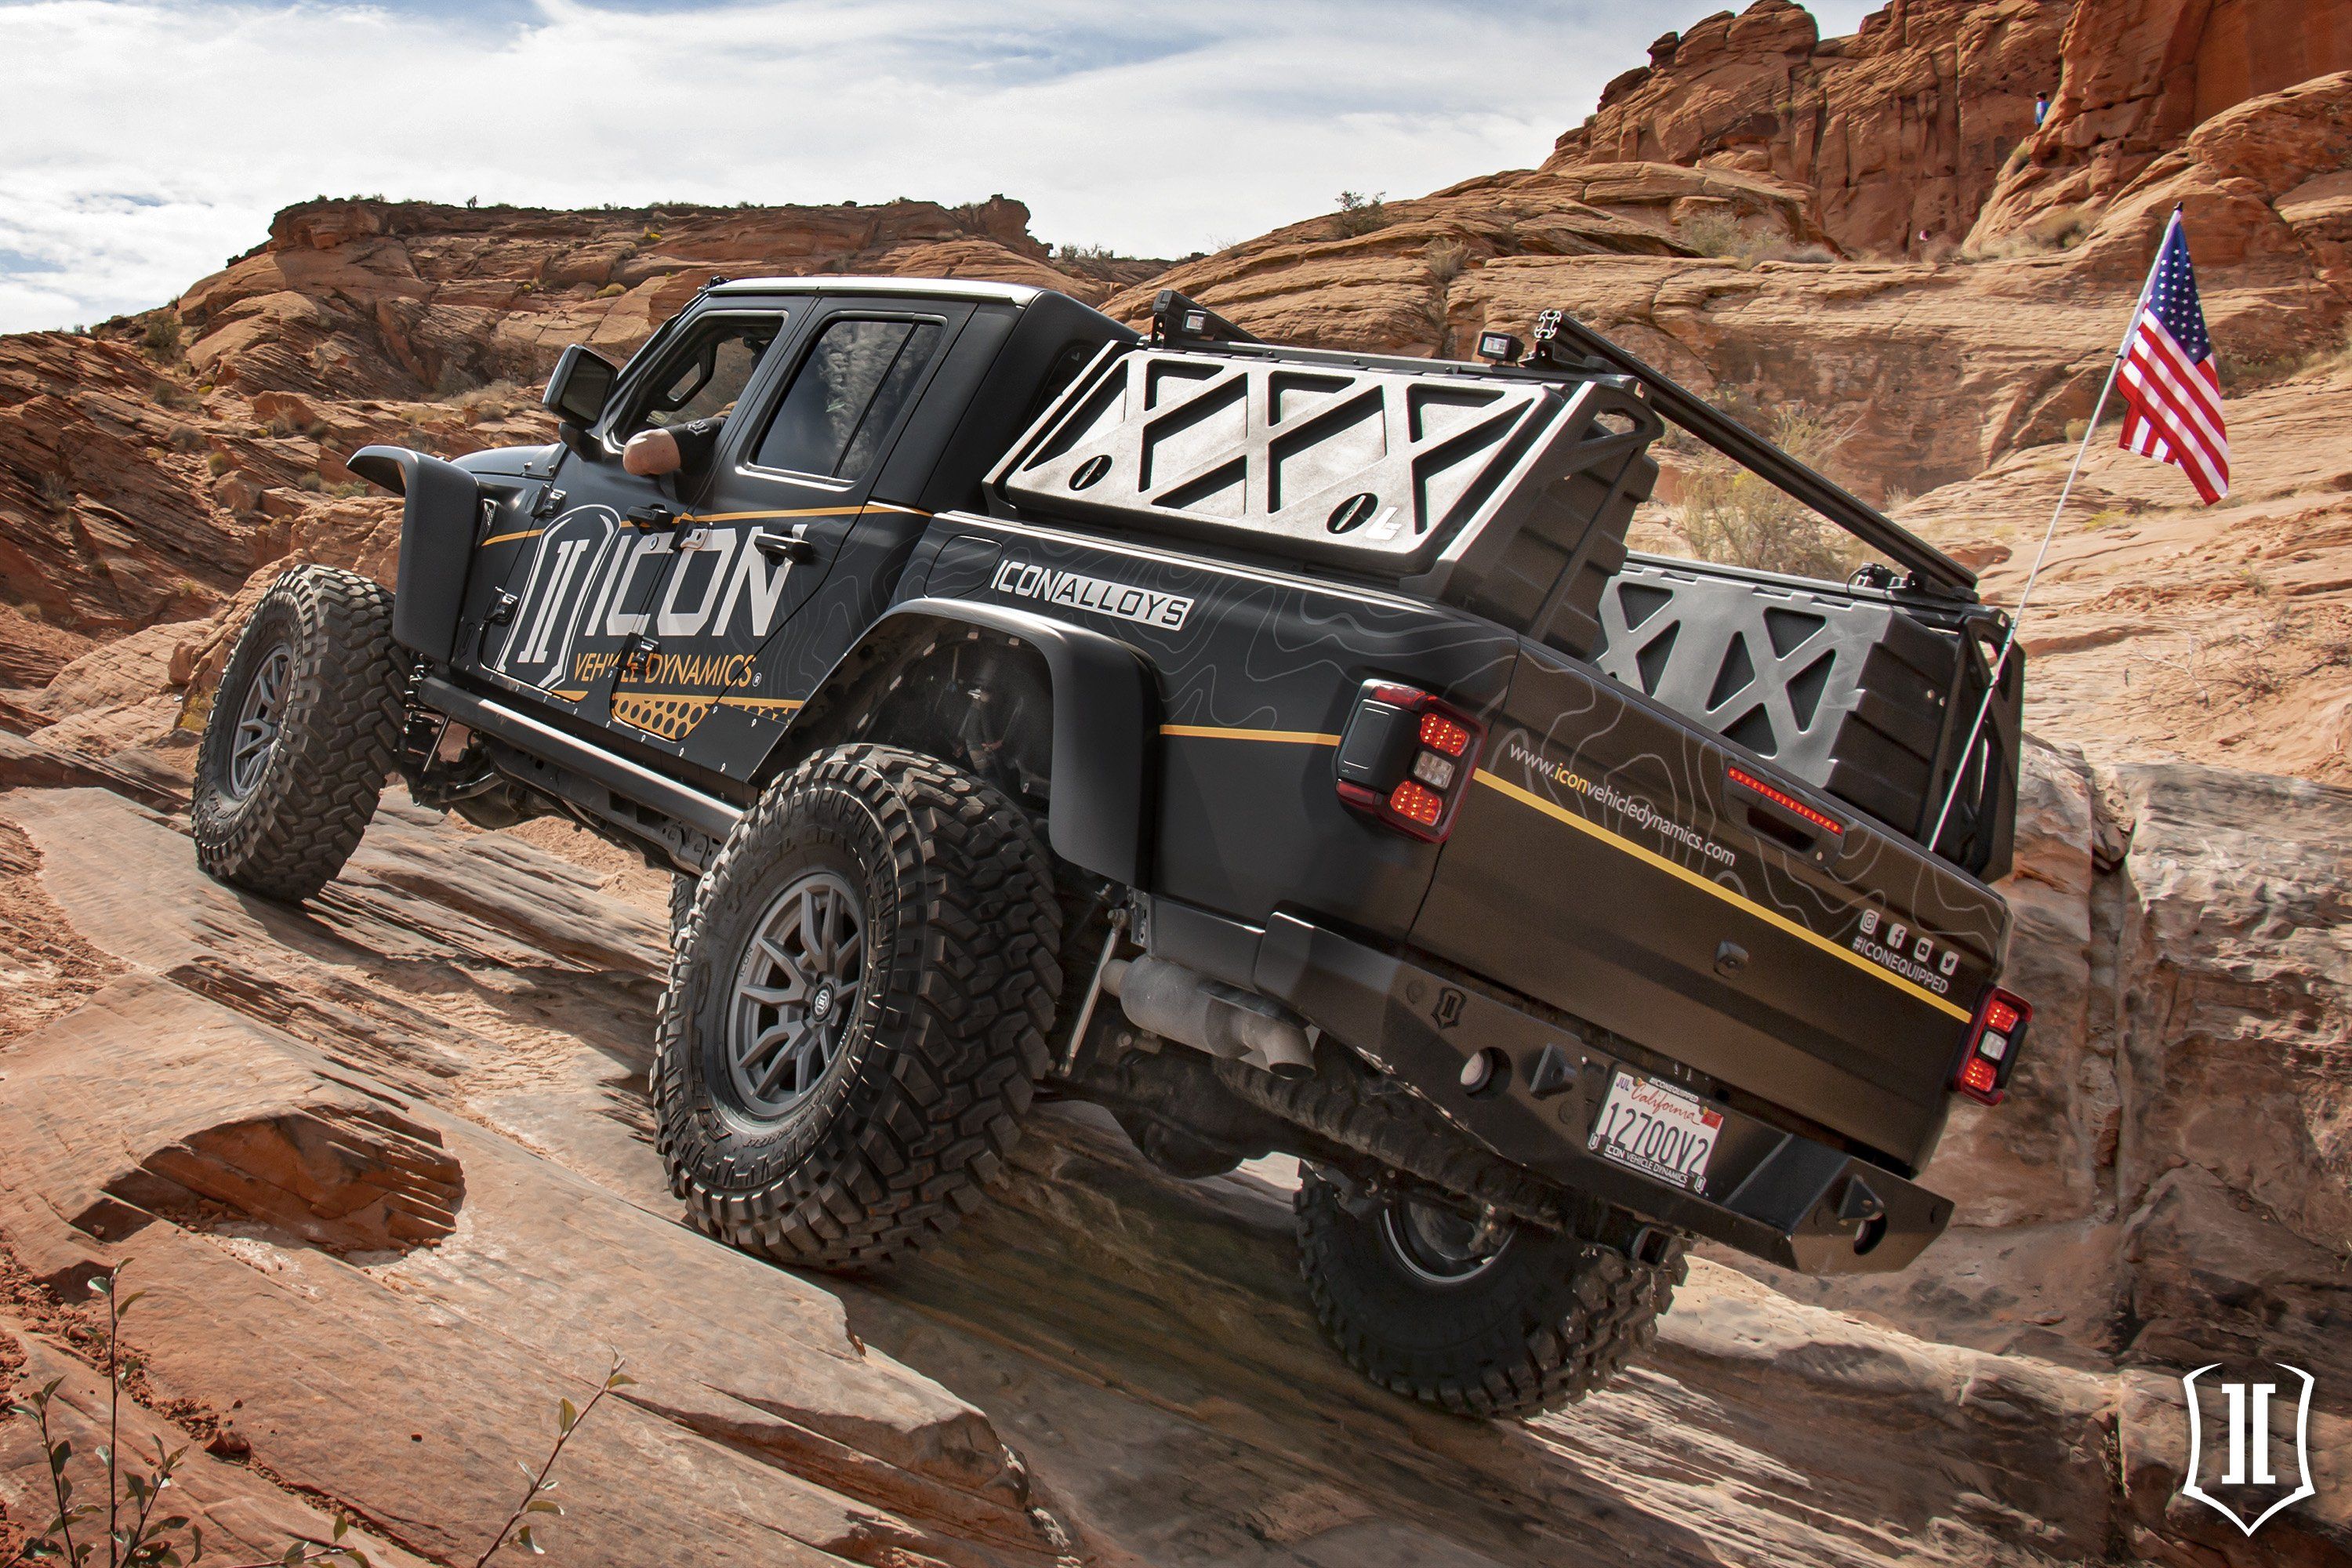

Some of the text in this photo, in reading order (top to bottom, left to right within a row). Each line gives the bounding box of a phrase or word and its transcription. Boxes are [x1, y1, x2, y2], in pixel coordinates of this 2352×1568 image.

[584, 524, 808, 637] ICON
[1509, 742, 1736, 866] www.iconvehicledynamics.com
[1852, 935, 1949, 994] #ICONEQUIPPED
[1631, 1083, 1700, 1125] California
[1605, 1144, 1626, 1159] ICON
[1626, 1151, 1653, 1169] VEHICLE
[1653, 1163, 1689, 1184] DYNAMICS
